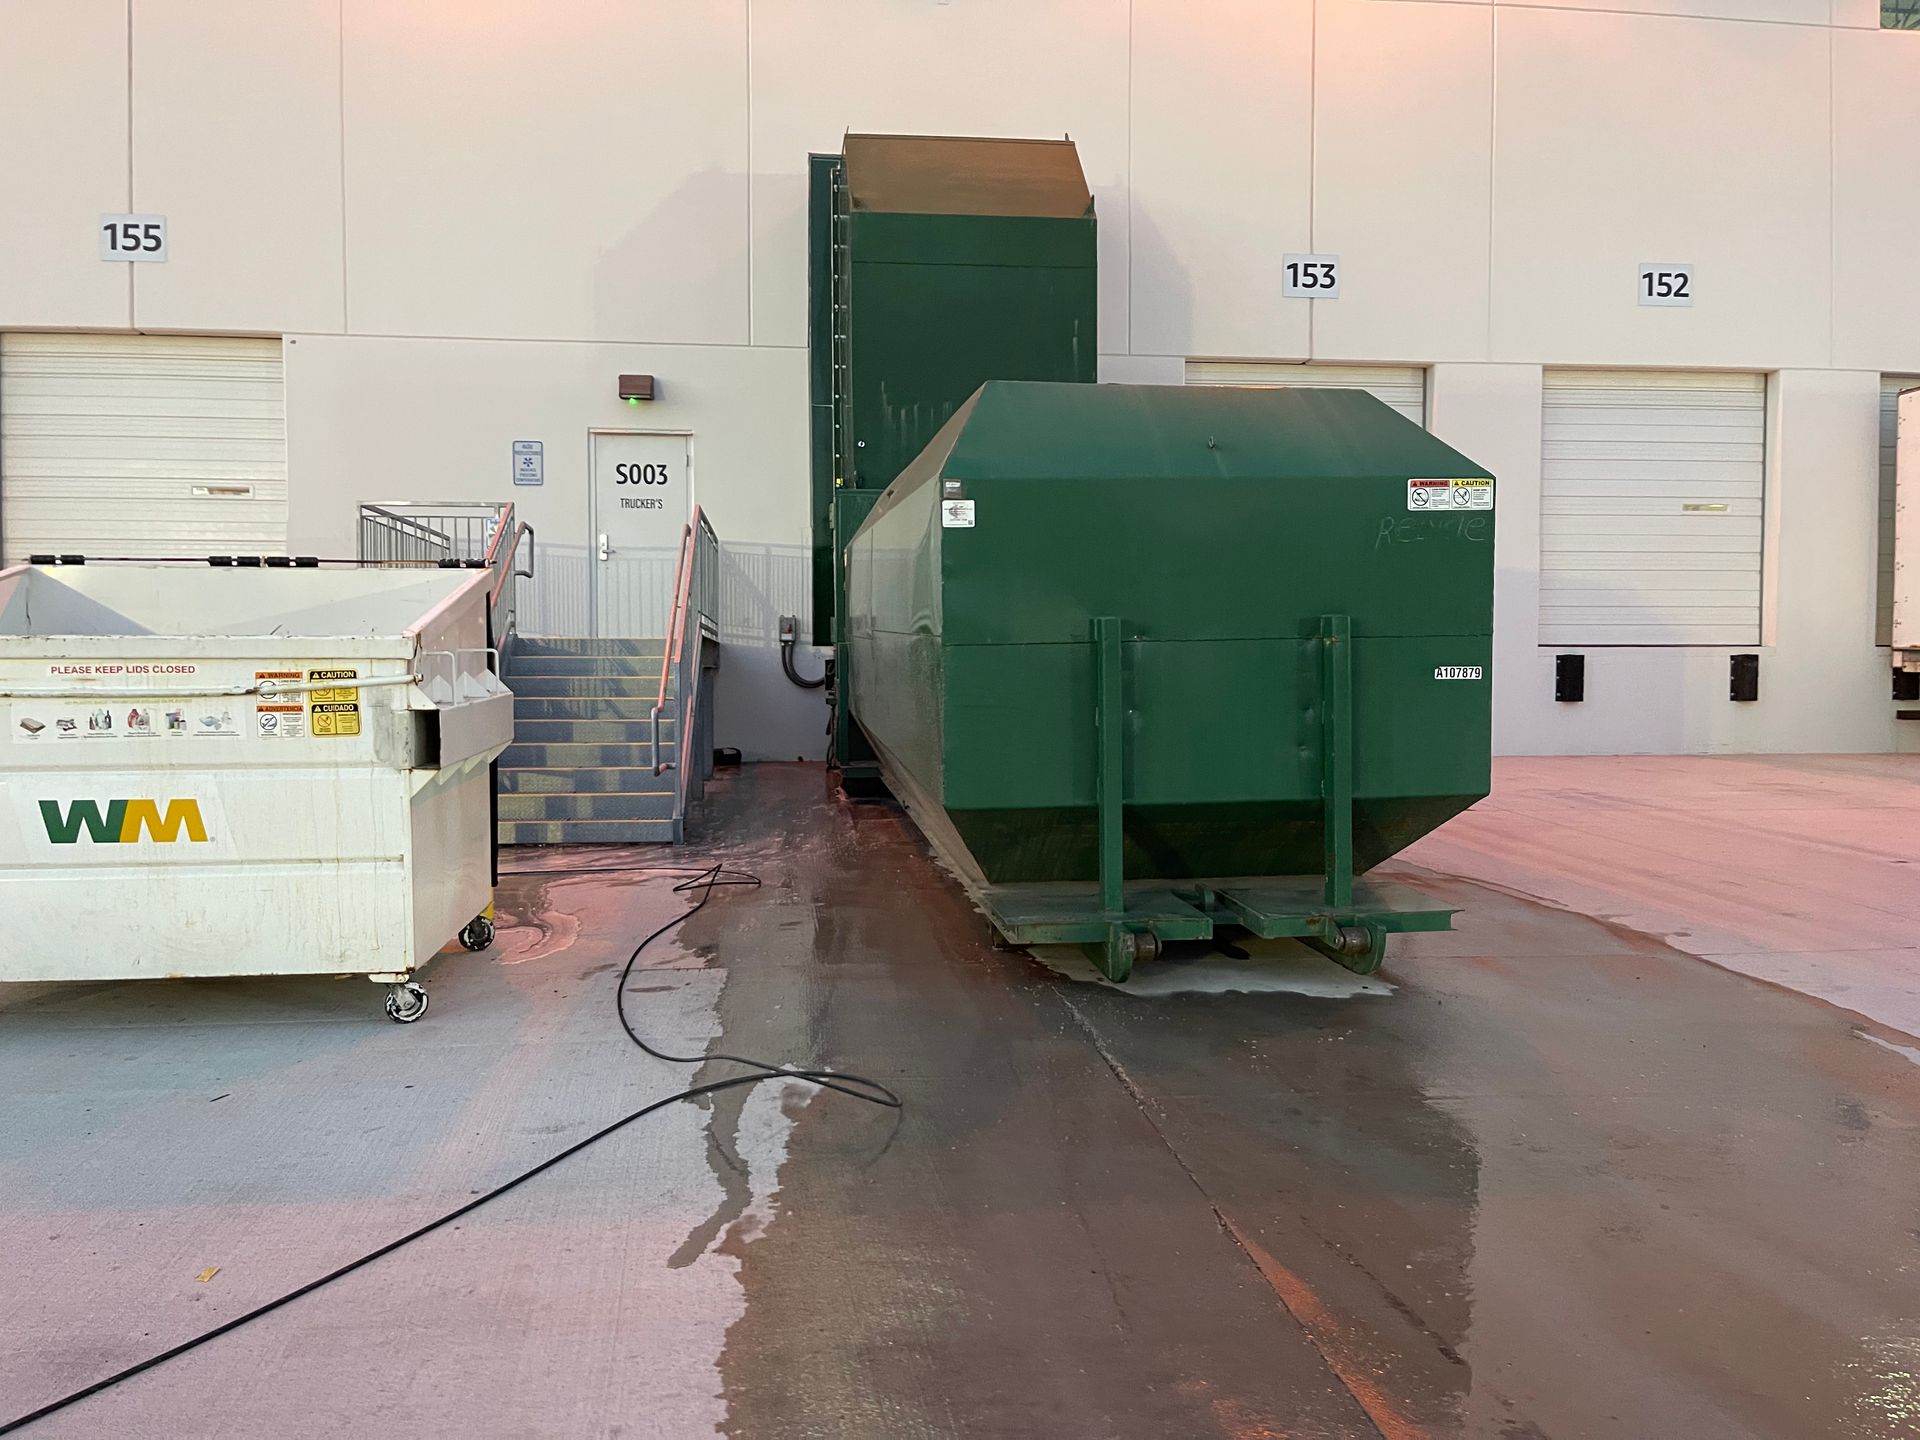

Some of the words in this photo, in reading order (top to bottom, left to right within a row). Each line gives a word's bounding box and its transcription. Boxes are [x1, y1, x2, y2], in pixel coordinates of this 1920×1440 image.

[103, 223, 162, 252] 155
[1286, 262, 1336, 289] 153
[1642, 272, 1690, 297] 152
[615, 463, 668, 485] S003
[620, 498, 663, 509] TRUCKER'S
[51, 666, 92, 674] PLEASE
[95, 665, 123, 674] KEEP
[126, 665, 150, 674] LIDS
[152, 665, 195, 674] CLOSED
[320, 671, 355, 679] CAUTION
[1436, 667, 1481, 678] A107879
[322, 704, 354, 712] CUIDADO
[38, 799, 209, 843] WM
